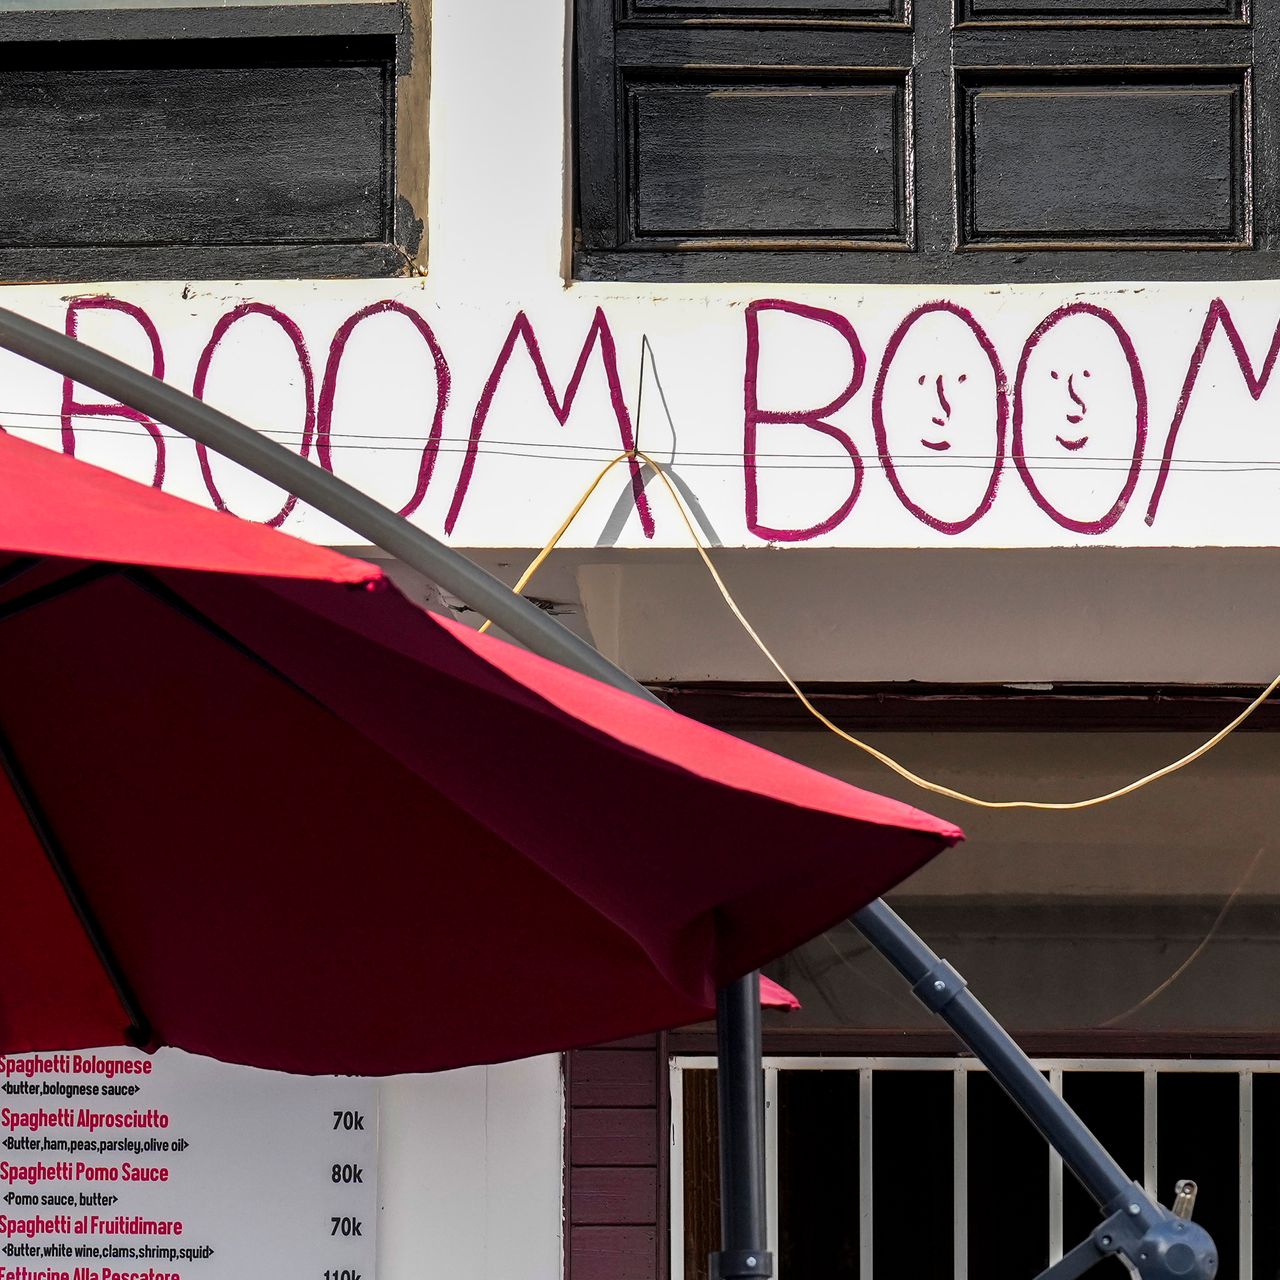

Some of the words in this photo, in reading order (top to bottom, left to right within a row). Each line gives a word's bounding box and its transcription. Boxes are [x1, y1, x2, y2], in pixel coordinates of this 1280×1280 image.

[60, 294, 658, 539] BOOM
[73, 1055, 152, 1078] Bolognese
[1, 1108, 74, 1131] Spaghetti
[77, 1109, 168, 1132] Alprosciutto
[333, 1111, 364, 1130] 70k
[0, 1161, 72, 1185] Spaghetti
[76, 1162, 118, 1181] Pomo
[122, 1162, 168, 1181] Sauce
[332, 1164, 363, 1183] 80k
